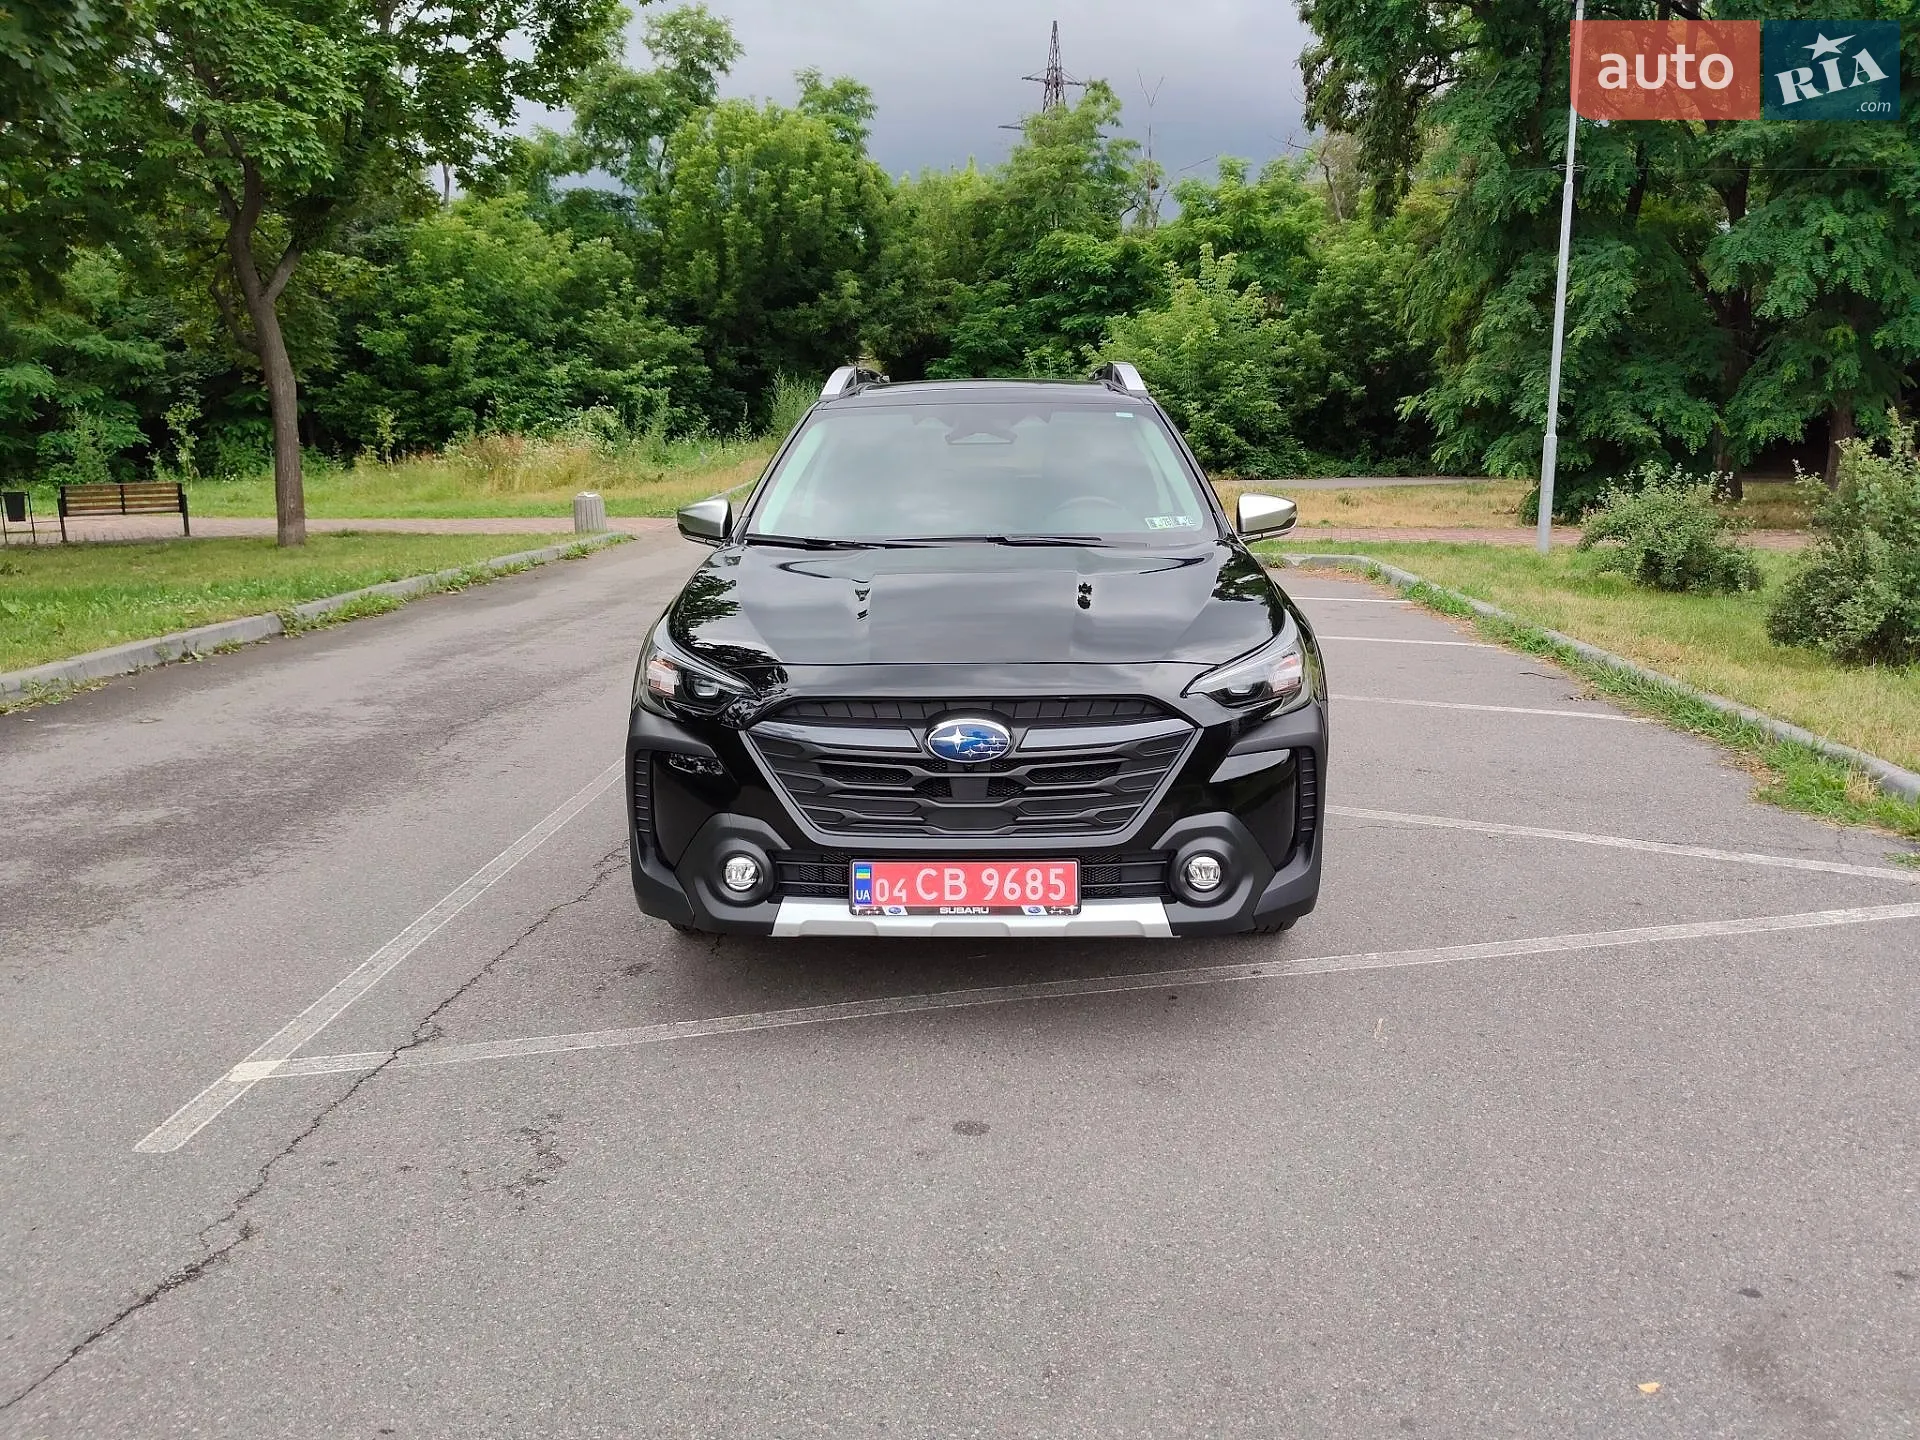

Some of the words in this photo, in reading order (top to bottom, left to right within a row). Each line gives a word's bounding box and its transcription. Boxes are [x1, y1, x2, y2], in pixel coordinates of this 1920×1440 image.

[875, 878, 907, 903] 04
[915, 868, 968, 901] CB
[980, 868, 1066, 901] 9685
[856, 889, 871, 900] UA
[939, 906, 990, 915] SUBARU
